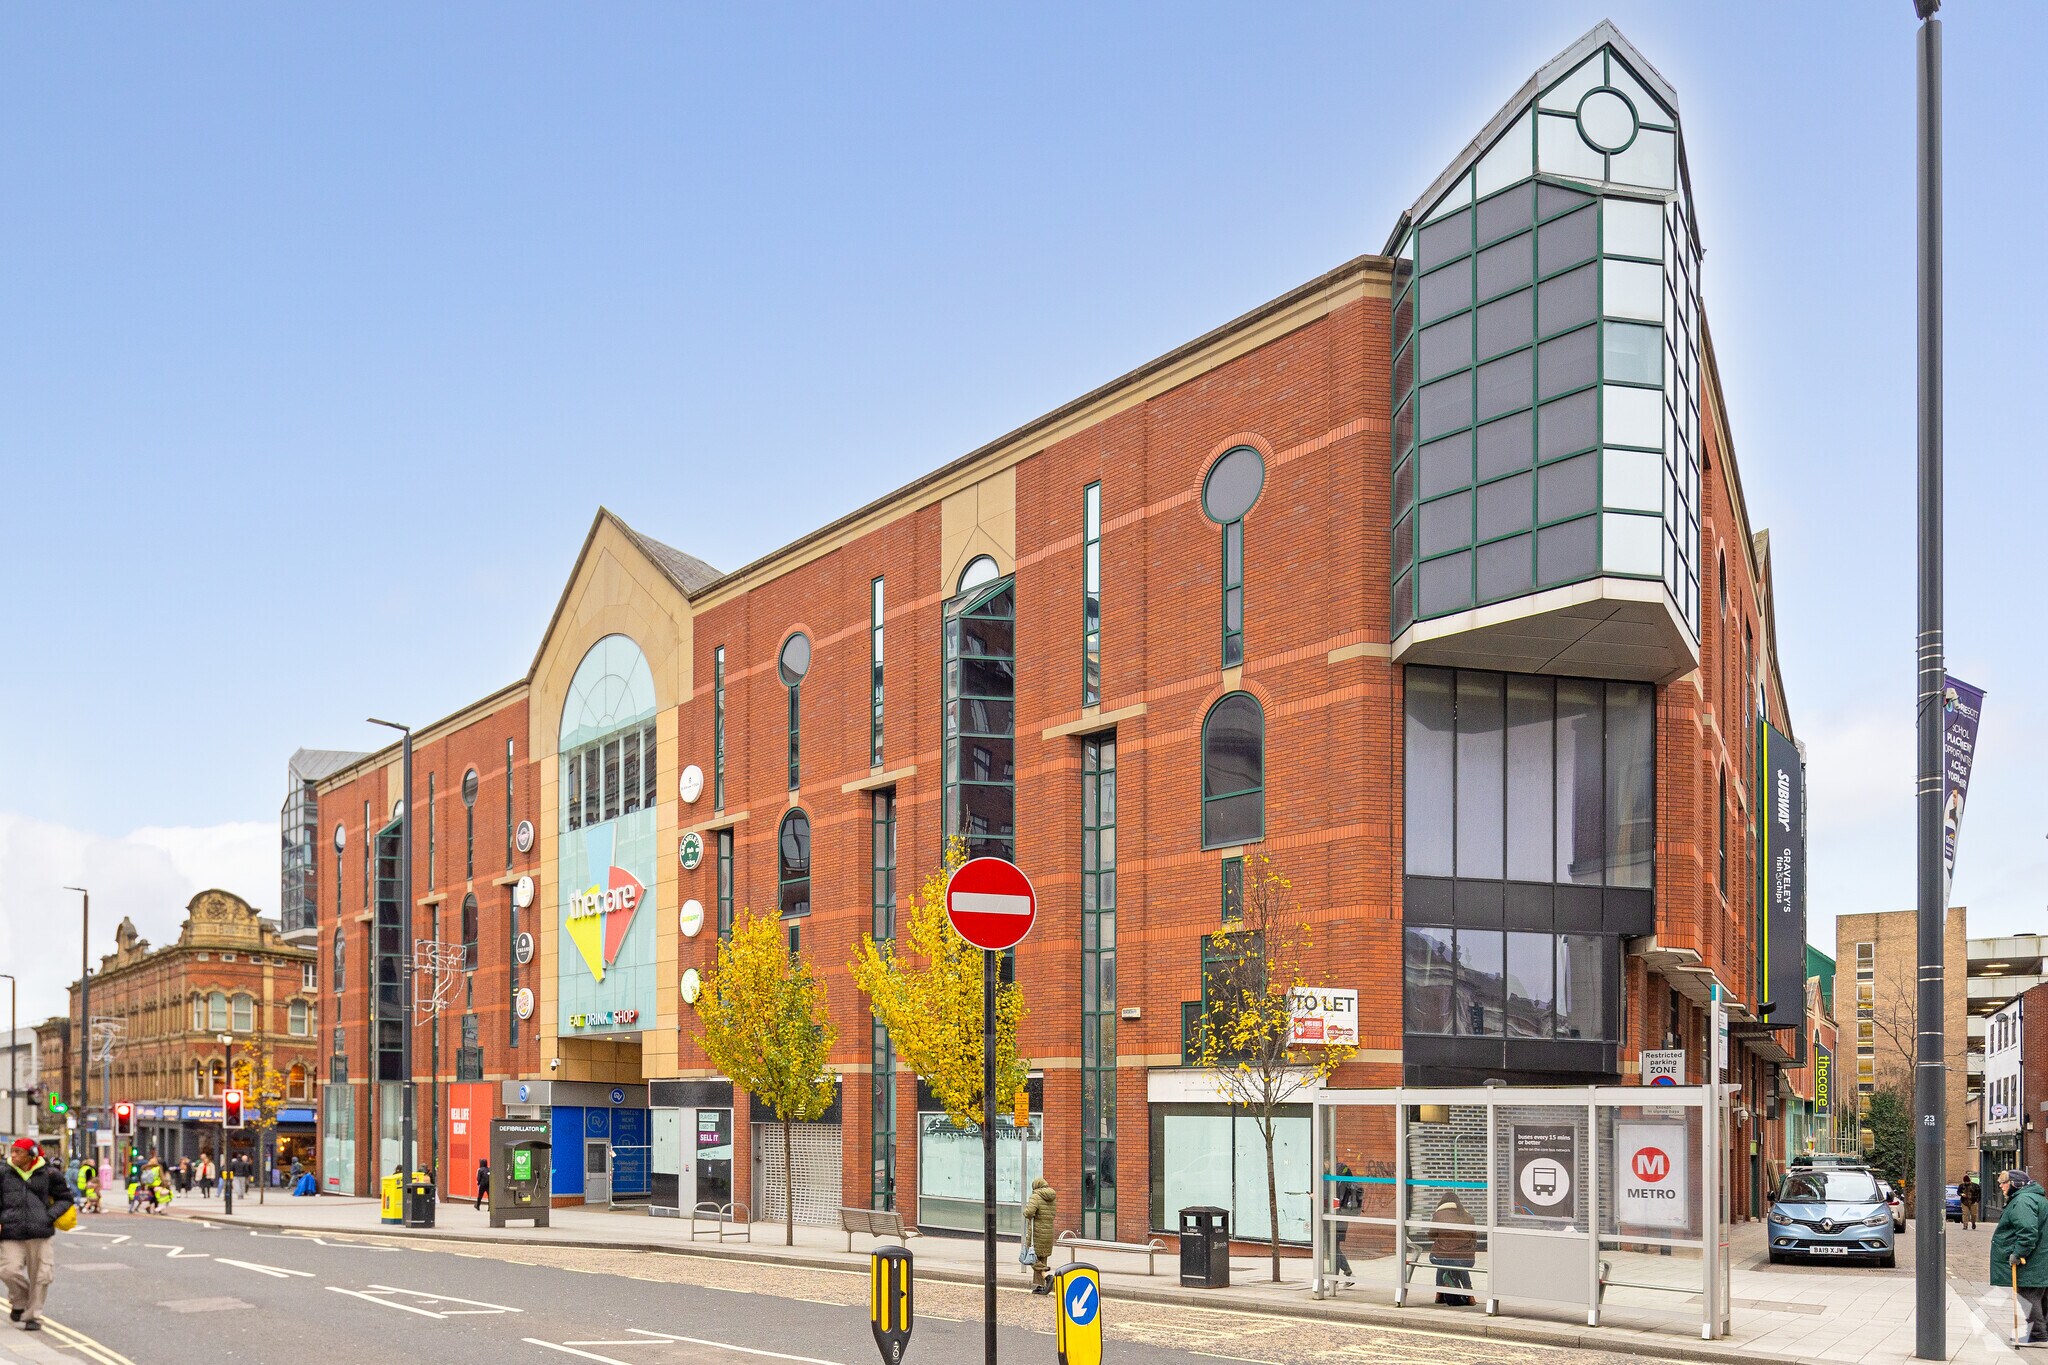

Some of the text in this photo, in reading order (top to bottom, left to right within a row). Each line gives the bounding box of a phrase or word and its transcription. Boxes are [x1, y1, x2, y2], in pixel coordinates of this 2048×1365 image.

[1777, 769, 1790, 832] SUBWAY
[1783, 848, 1791, 913] GRAVELEY'S
[569, 884, 636, 920] thecore
[1294, 995, 1354, 1012] TO LET
[569, 1009, 635, 1027] EAT DRINK SHOP
[1818, 1055, 1830, 1106] thecore
[700, 1134, 712, 1142] SELL
[1637, 1154, 1665, 1175] M
[1627, 1188, 1676, 1199] METRO
